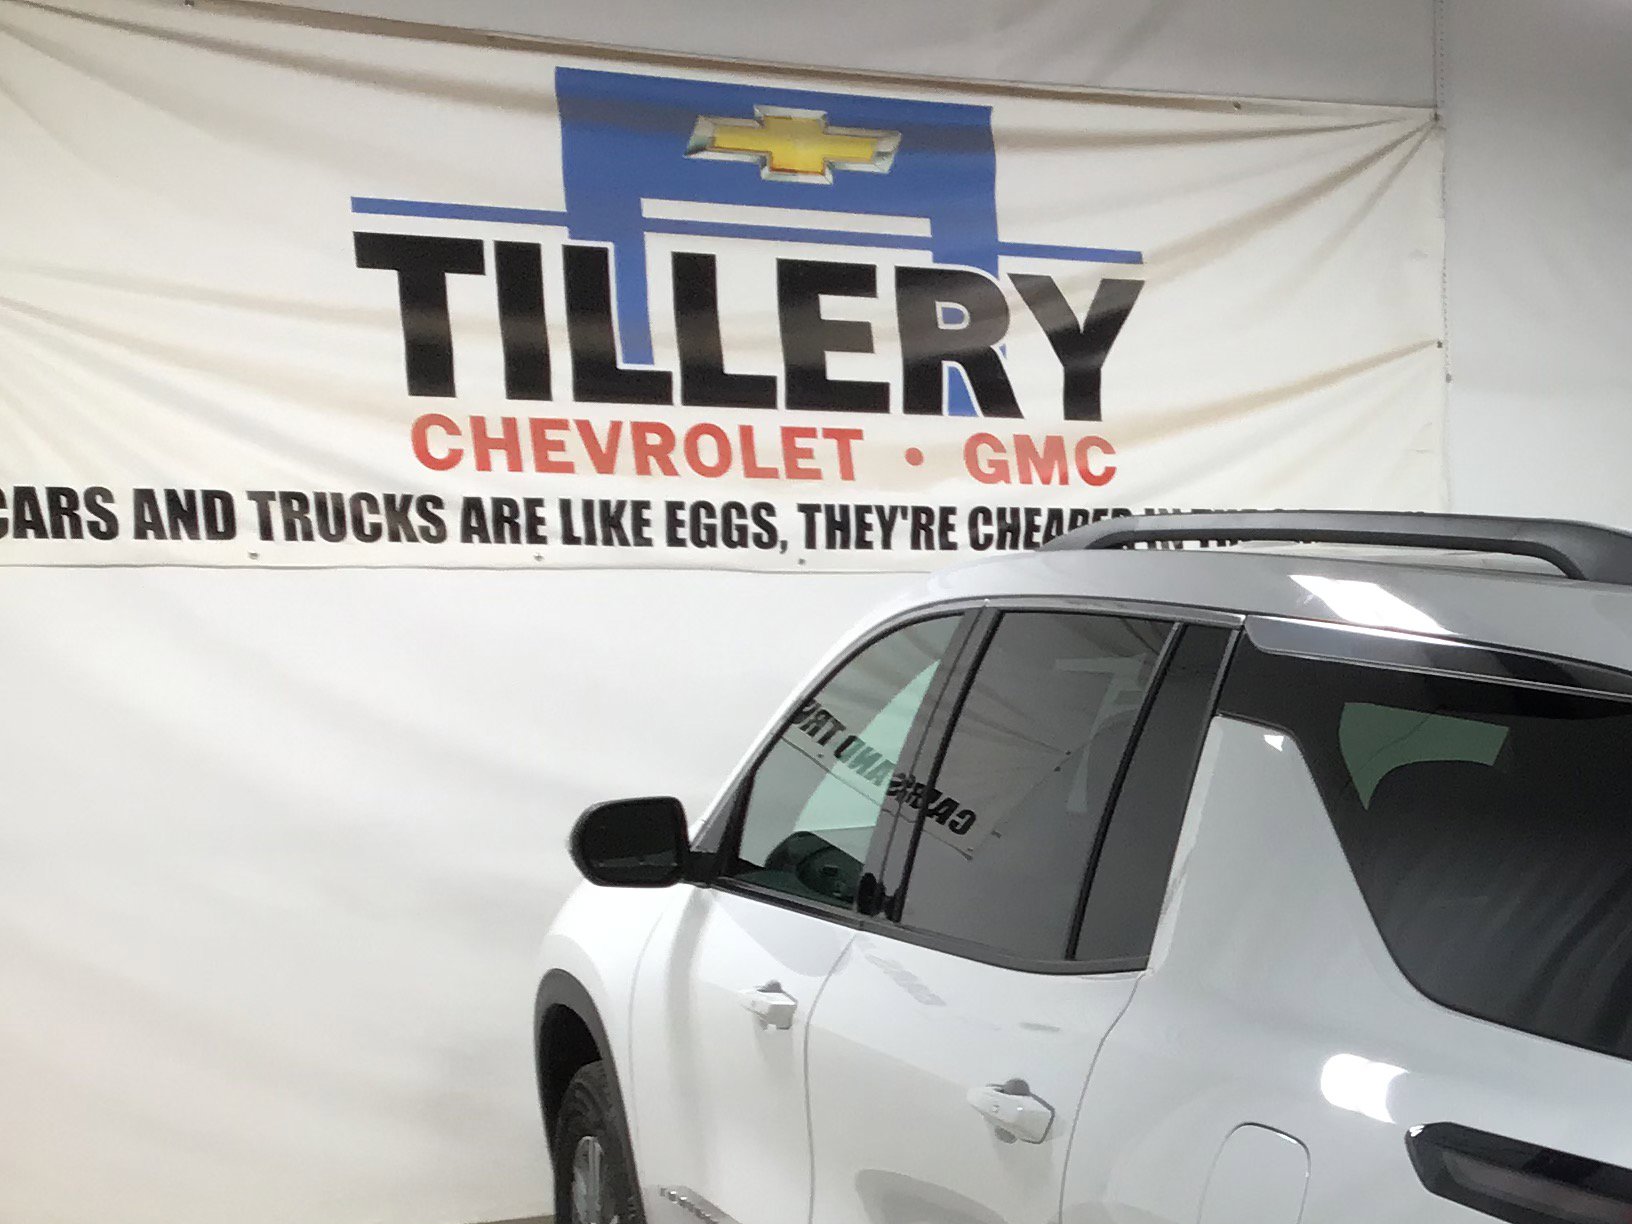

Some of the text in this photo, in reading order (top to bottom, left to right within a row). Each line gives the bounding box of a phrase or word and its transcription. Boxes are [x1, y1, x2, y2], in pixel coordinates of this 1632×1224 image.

[353, 231, 1145, 421] TILLERY
[411, 413, 1117, 486] CHEVROLET GMC
[0, 485, 119, 541] ARS
[133, 488, 236, 541] AND
[246, 490, 447, 544] TRUCKS
[460, 495, 547, 545] ARE
[558, 498, 652, 548] LIKE
[666, 500, 788, 553] EGGS,
[800, 502, 957, 551] THEY'RE
